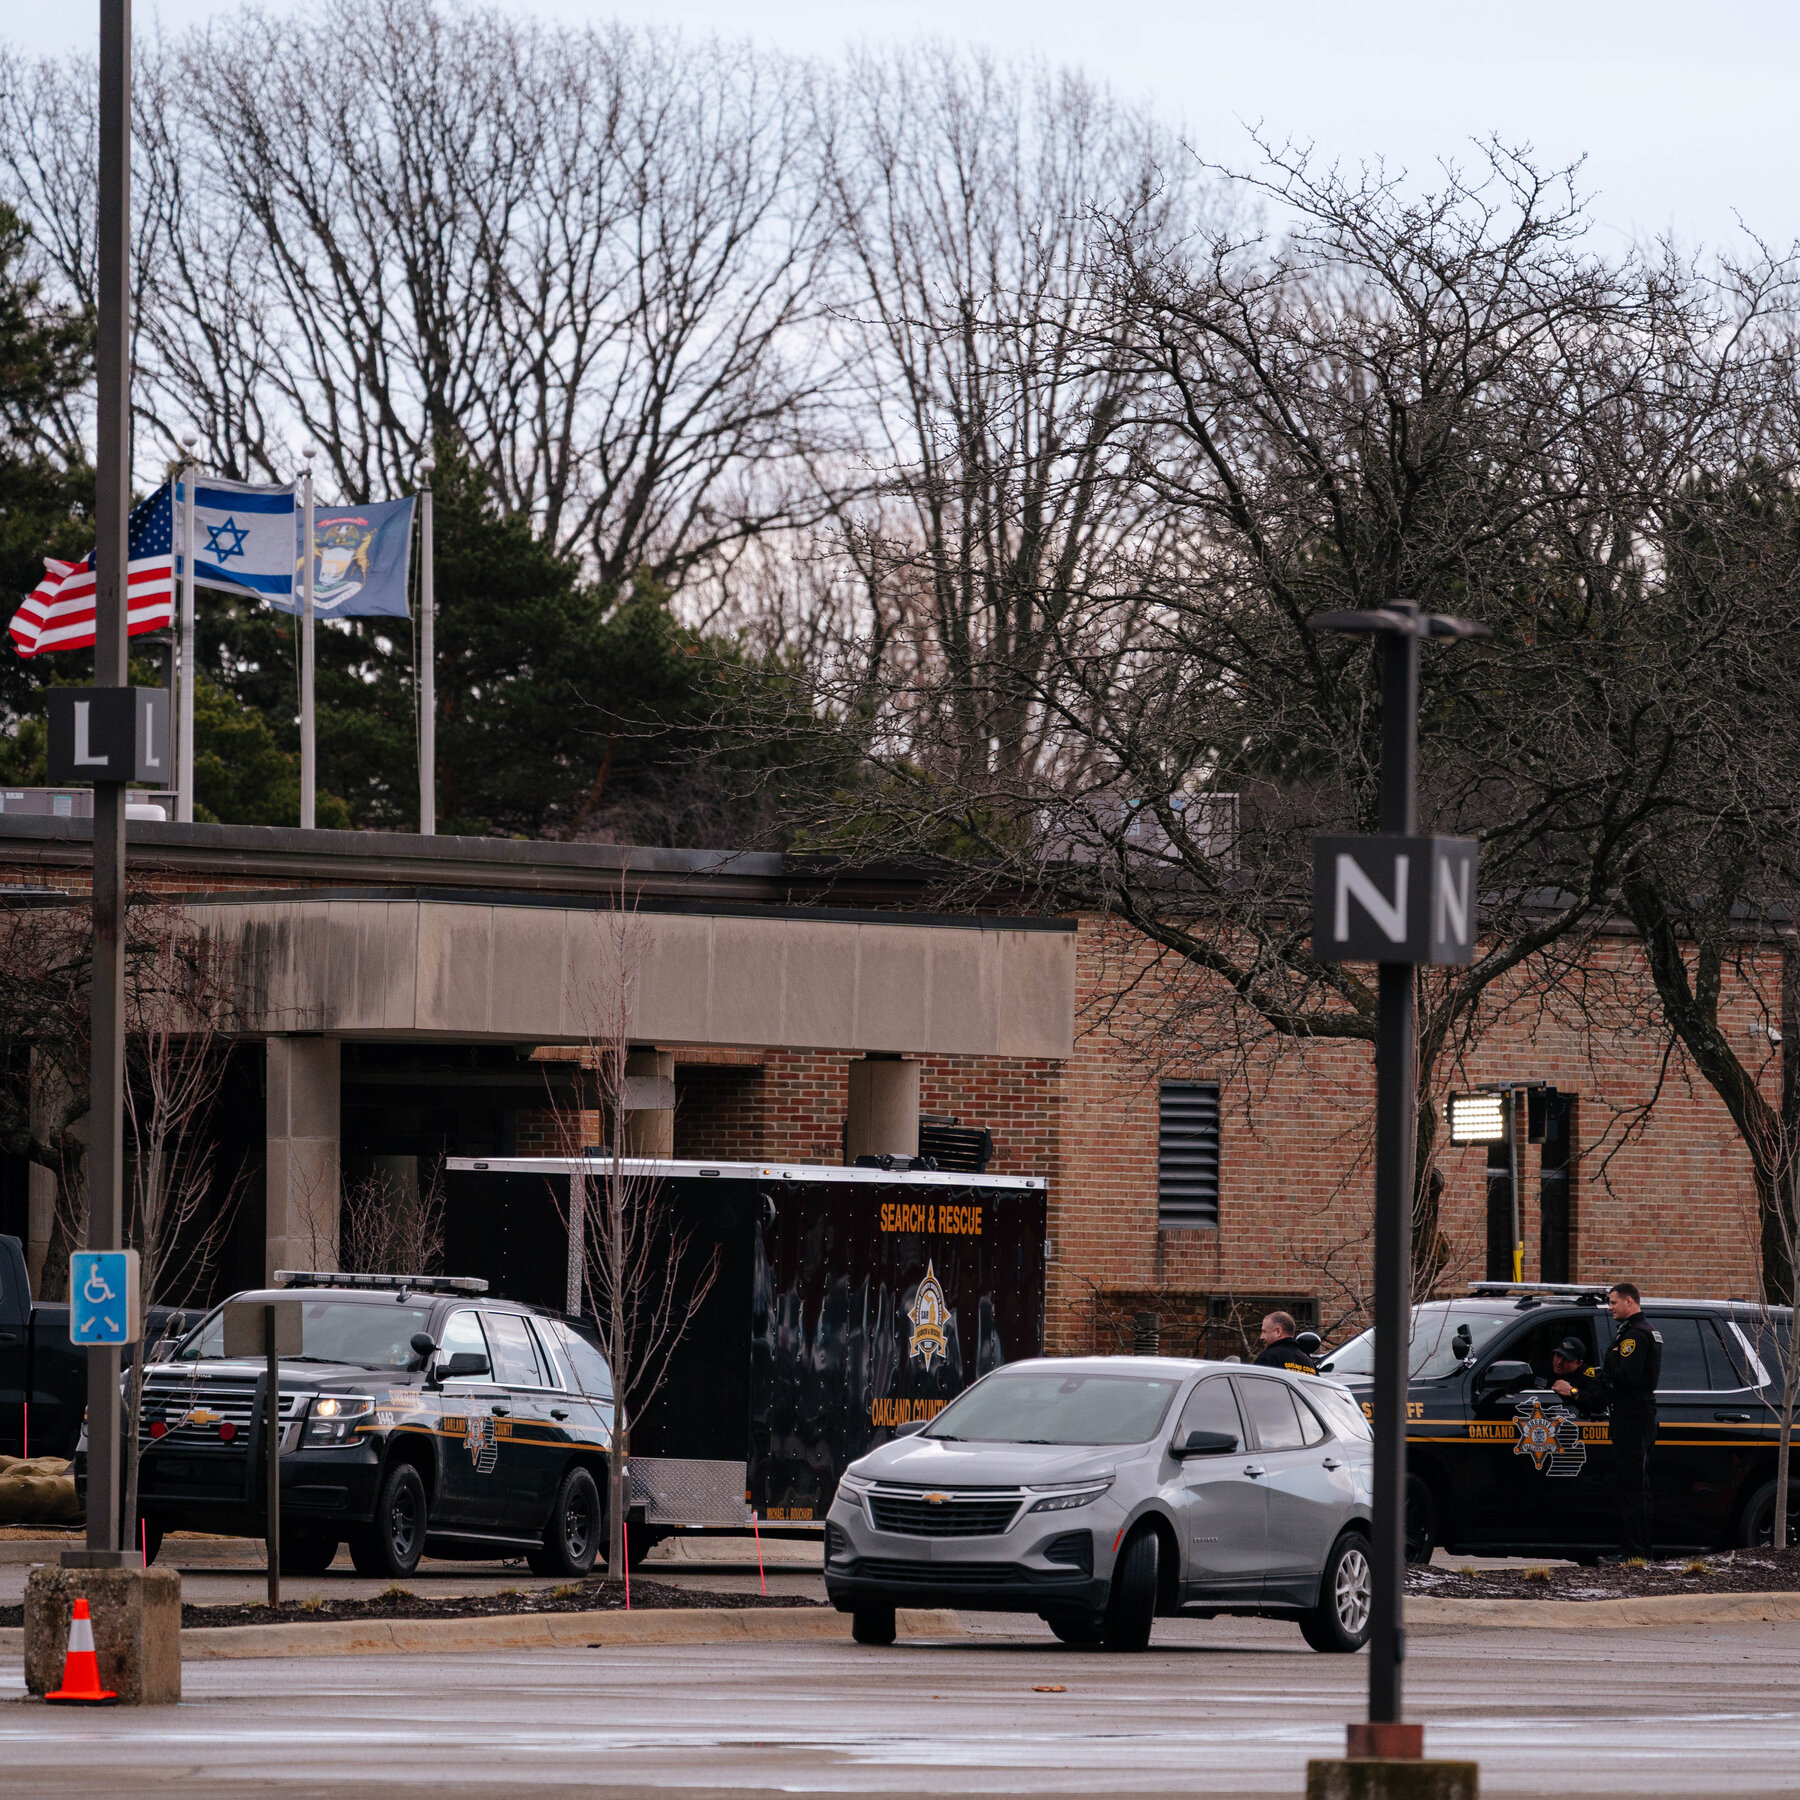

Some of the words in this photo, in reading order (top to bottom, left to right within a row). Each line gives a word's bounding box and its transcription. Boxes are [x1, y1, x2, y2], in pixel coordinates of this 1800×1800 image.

[74, 701, 108, 765] L
[146, 703, 159, 767] L
[1334, 854, 1409, 943] N
[1437, 855, 1470, 945] N
[880, 1203, 926, 1233] SEARCH
[927, 1204, 936, 1233] &
[938, 1205, 983, 1235] RESCUE
[376, 1412, 396, 1425] 1442
[443, 1417, 467, 1432] OAKLAND
[494, 1422, 513, 1437] COUNTY
[872, 1398, 911, 1427] OAKLAND
[1468, 1425, 1515, 1439] OAKLAND
[1582, 1427, 1609, 1440] COUN
